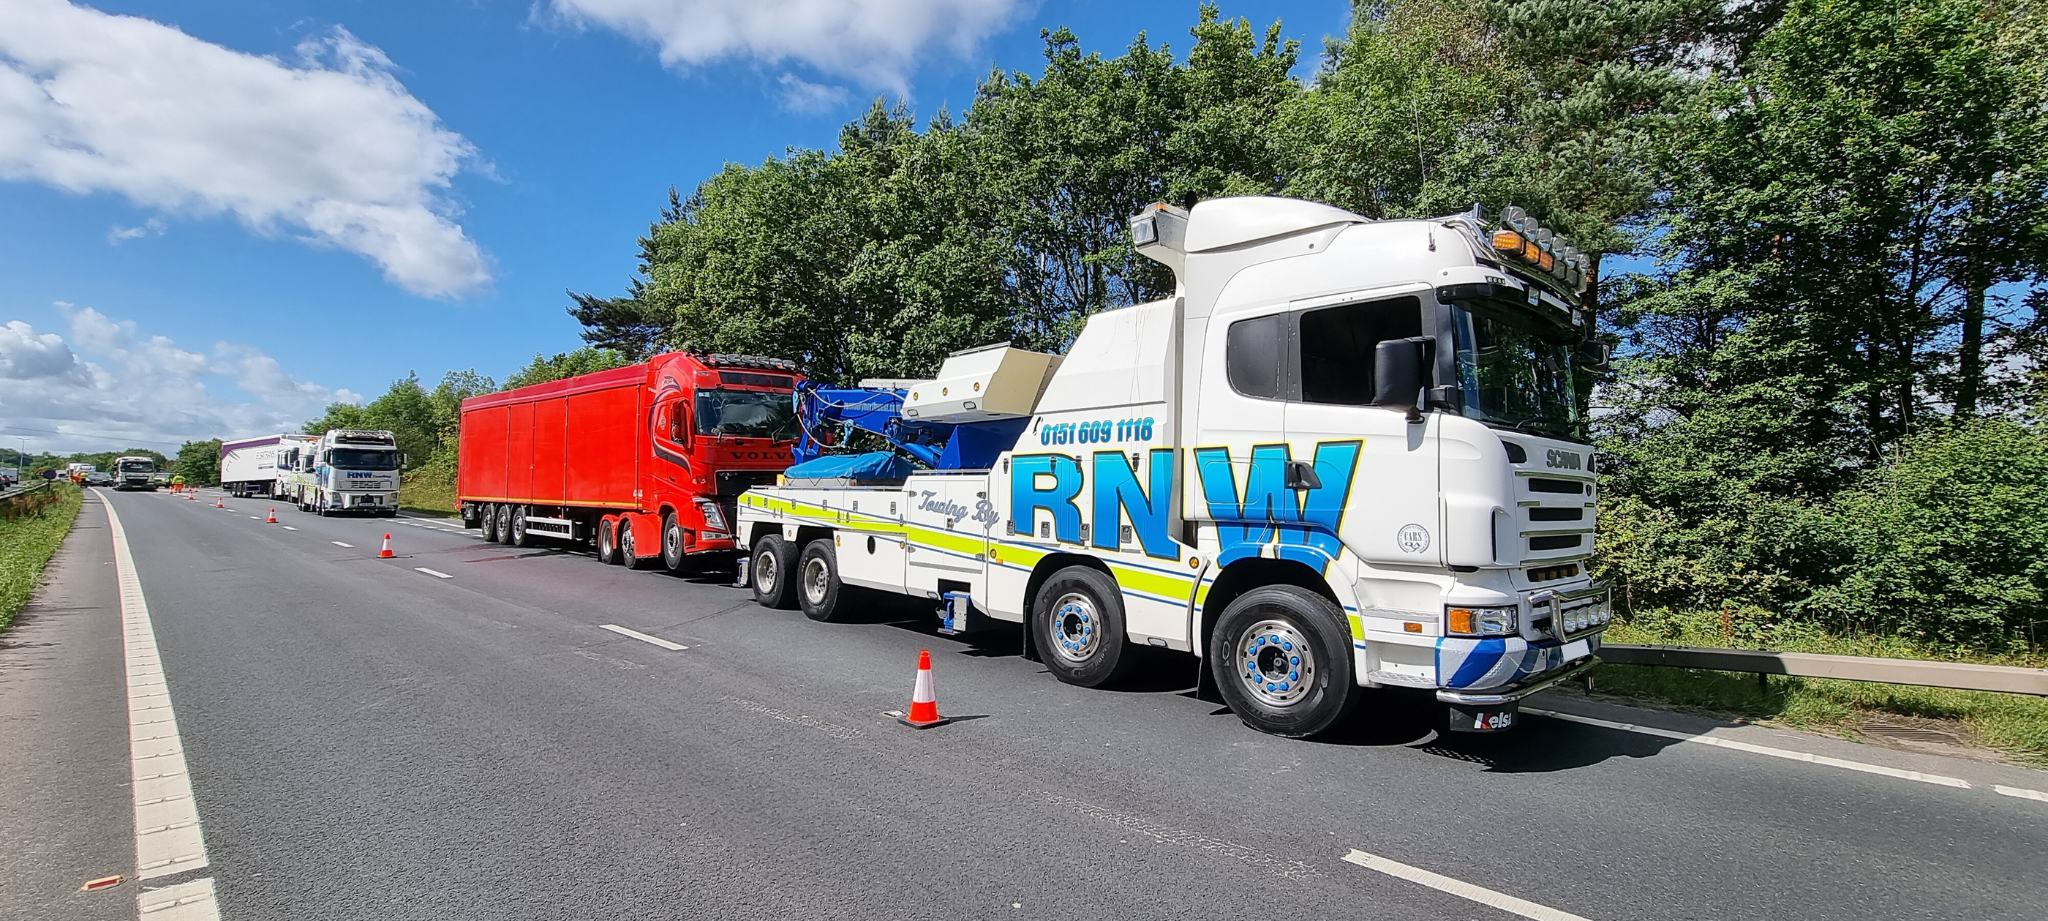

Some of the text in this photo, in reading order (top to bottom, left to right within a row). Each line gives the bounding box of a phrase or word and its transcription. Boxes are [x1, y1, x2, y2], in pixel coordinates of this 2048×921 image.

[1040, 416, 1155, 446] 0151 609 1118
[730, 451, 794, 460] VOLV
[1546, 449, 1581, 470] SCANIA
[918, 490, 1000, 529] Towing By
[1011, 439, 1367, 577] RNW
[1404, 531, 1422, 542] CARS
